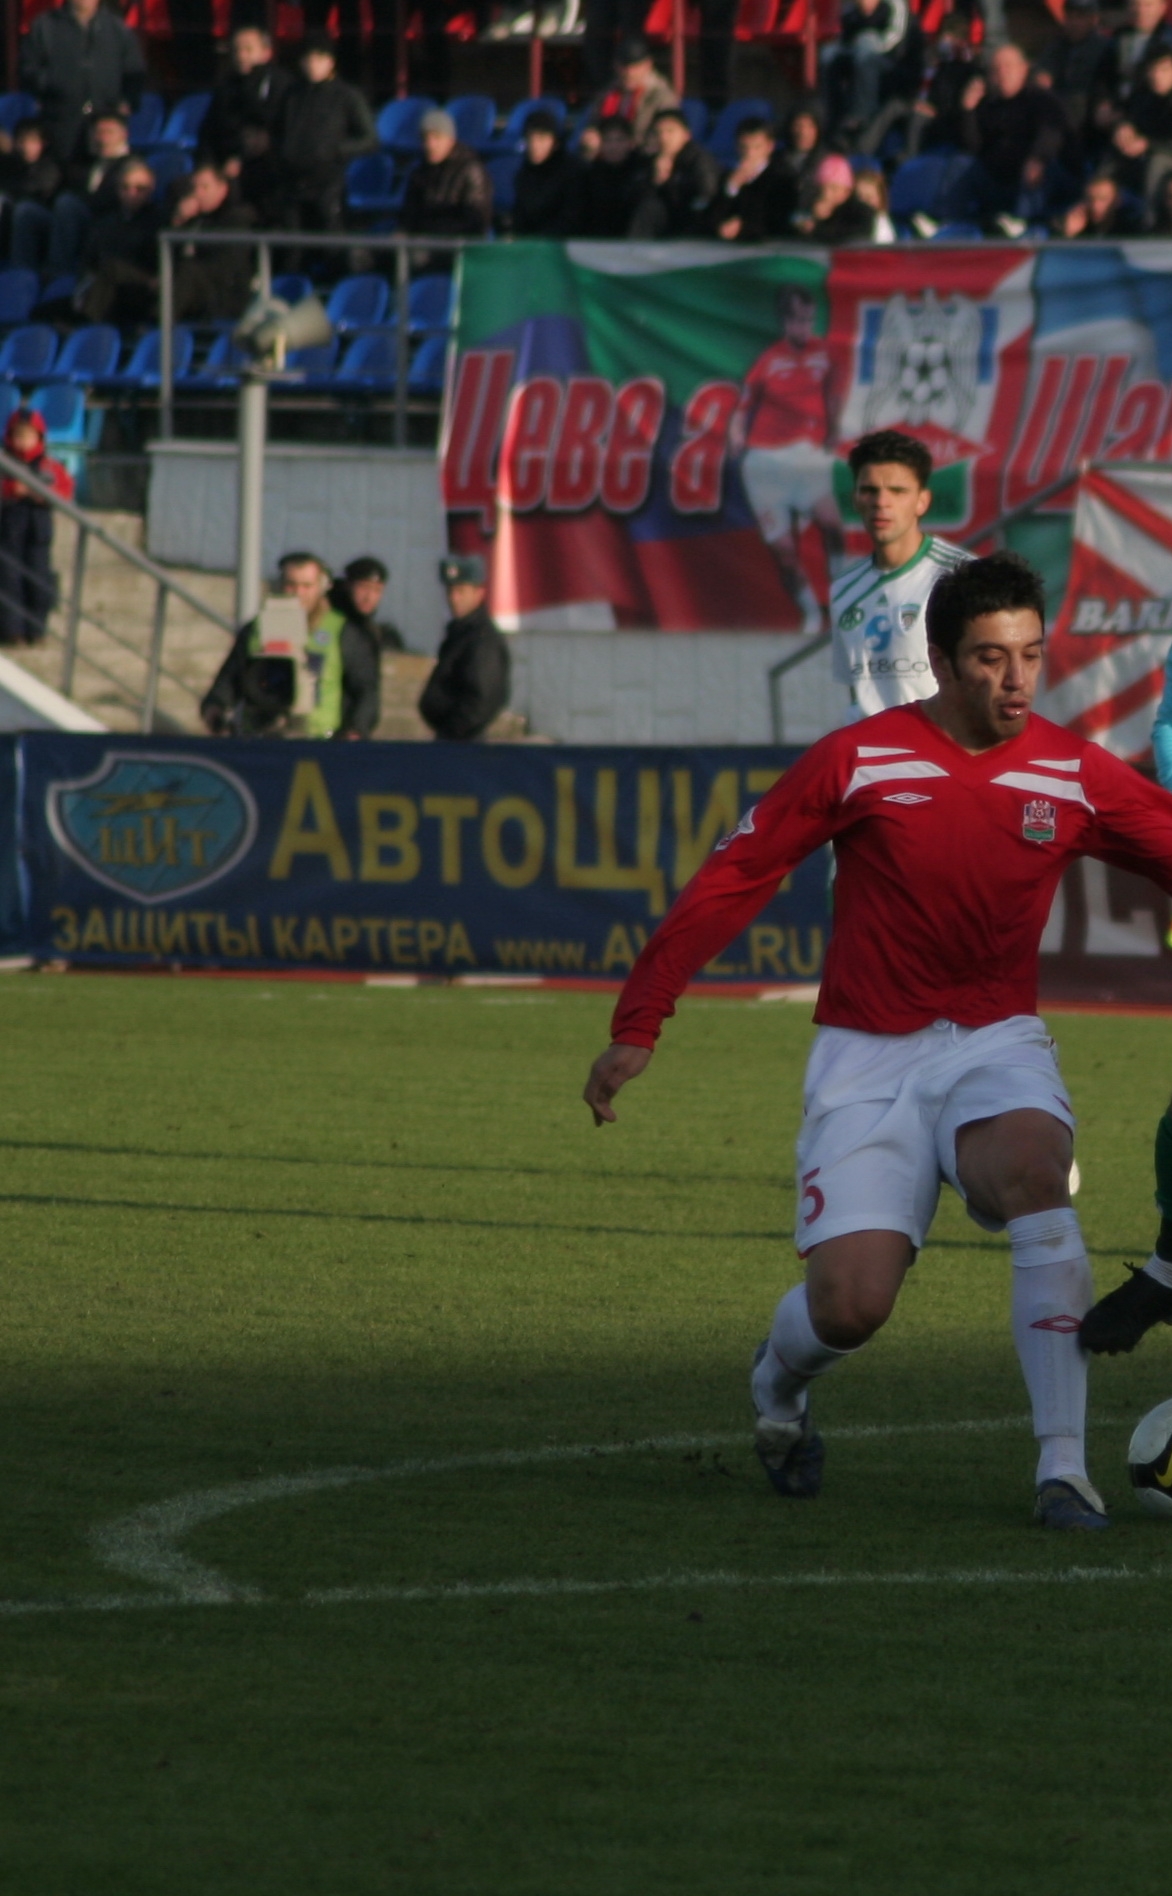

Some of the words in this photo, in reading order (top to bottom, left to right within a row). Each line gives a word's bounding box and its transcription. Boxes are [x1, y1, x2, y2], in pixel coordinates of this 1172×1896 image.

[50, 905, 263, 961] ЗАЩИТЫ
[271, 914, 477, 967] КАРТЕРА
[801, 1166, 825, 1227] 5
